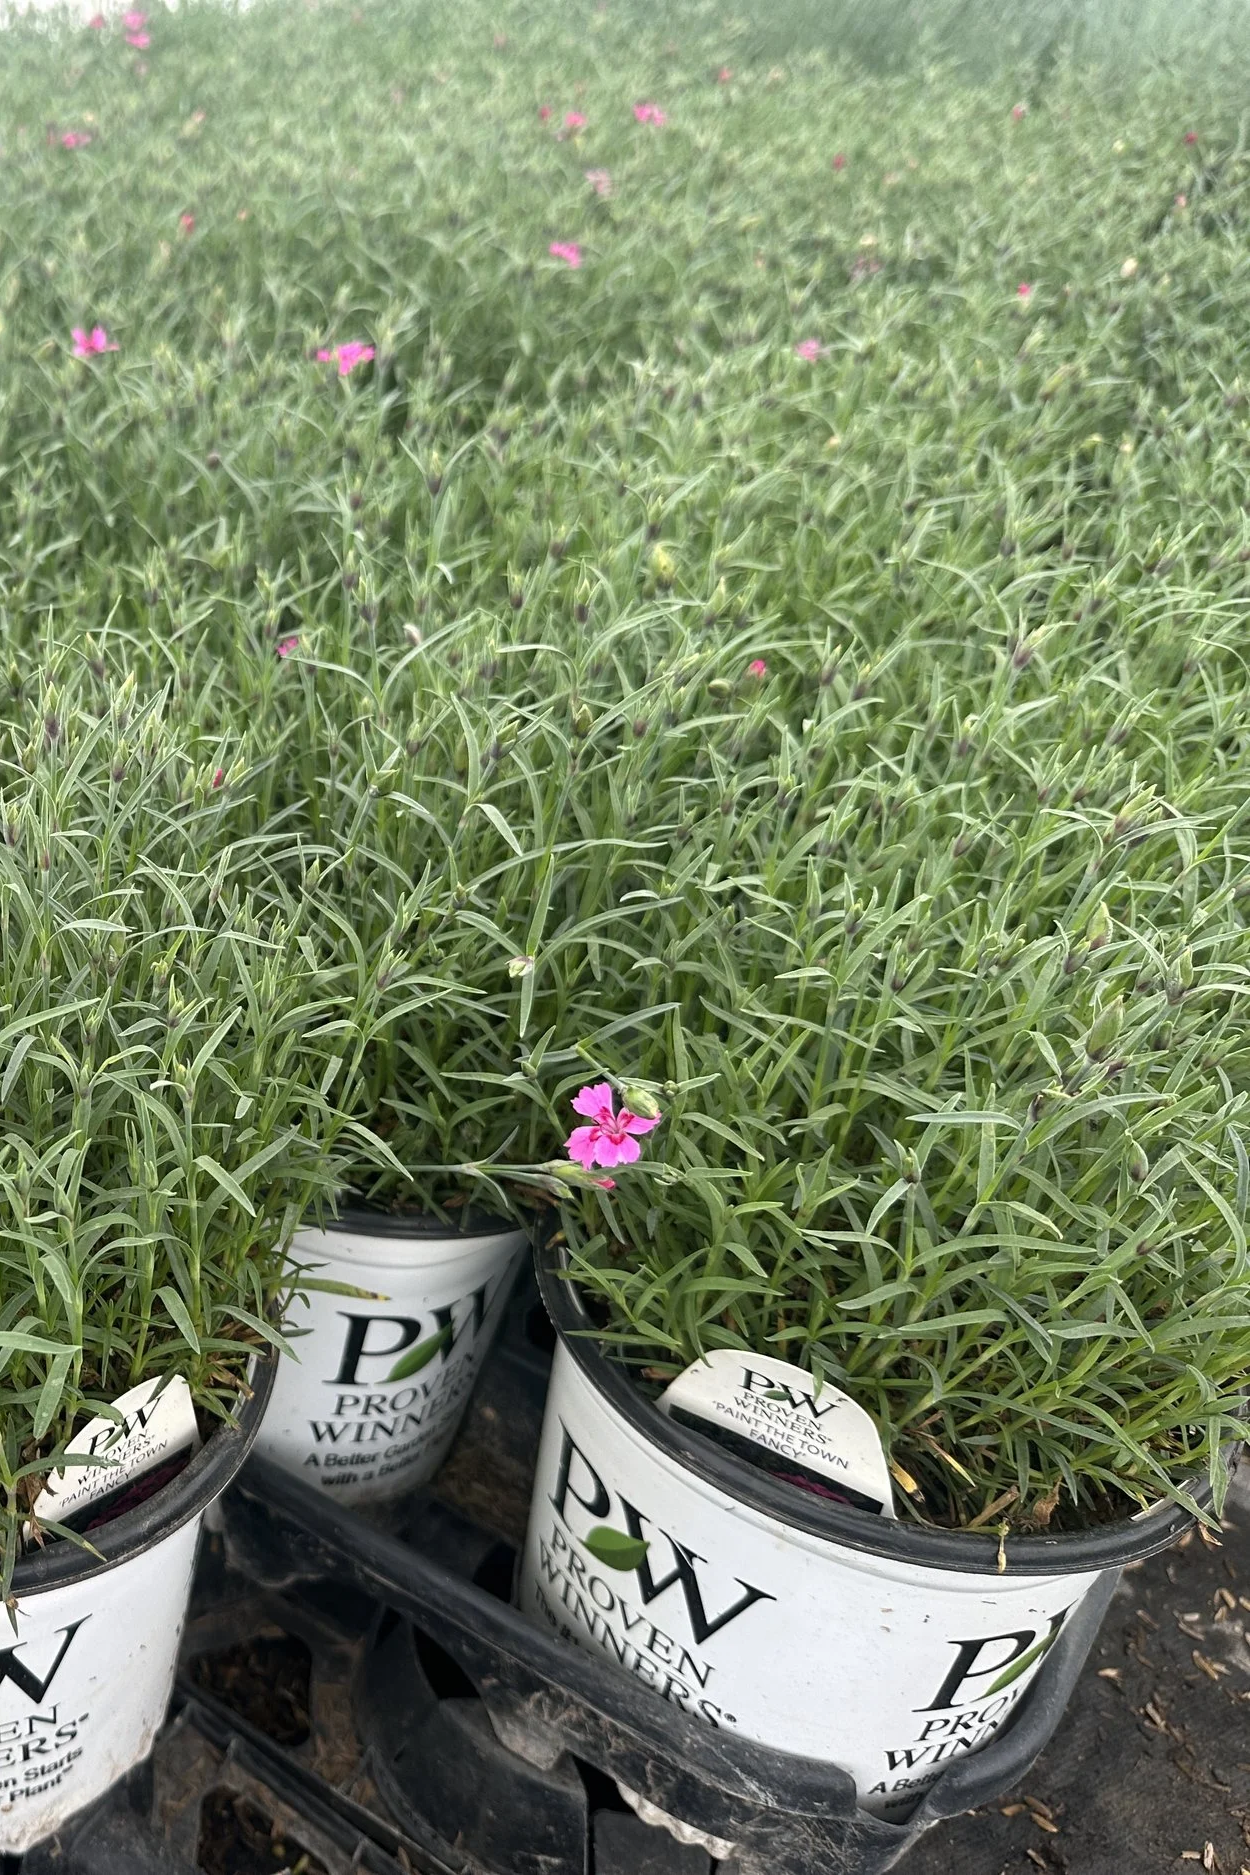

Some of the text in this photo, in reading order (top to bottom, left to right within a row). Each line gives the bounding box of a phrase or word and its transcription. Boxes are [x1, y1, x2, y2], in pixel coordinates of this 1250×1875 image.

[739, 1366, 840, 1418] PW
[743, 1392, 823, 1431] PROVEN
[89, 1394, 164, 1456] PW
[764, 1421, 794, 1444] THE
[799, 1439, 849, 1469] TOWN
[102, 1463, 126, 1485] THE
[130, 1440, 168, 1468] TOWN
[303, 1452, 319, 1467] A
[324, 1451, 379, 1467] Better
[548, 1413, 777, 1645] PW
[552, 1519, 716, 1689] PROVEN
[24, 1747, 83, 1780] Starts
